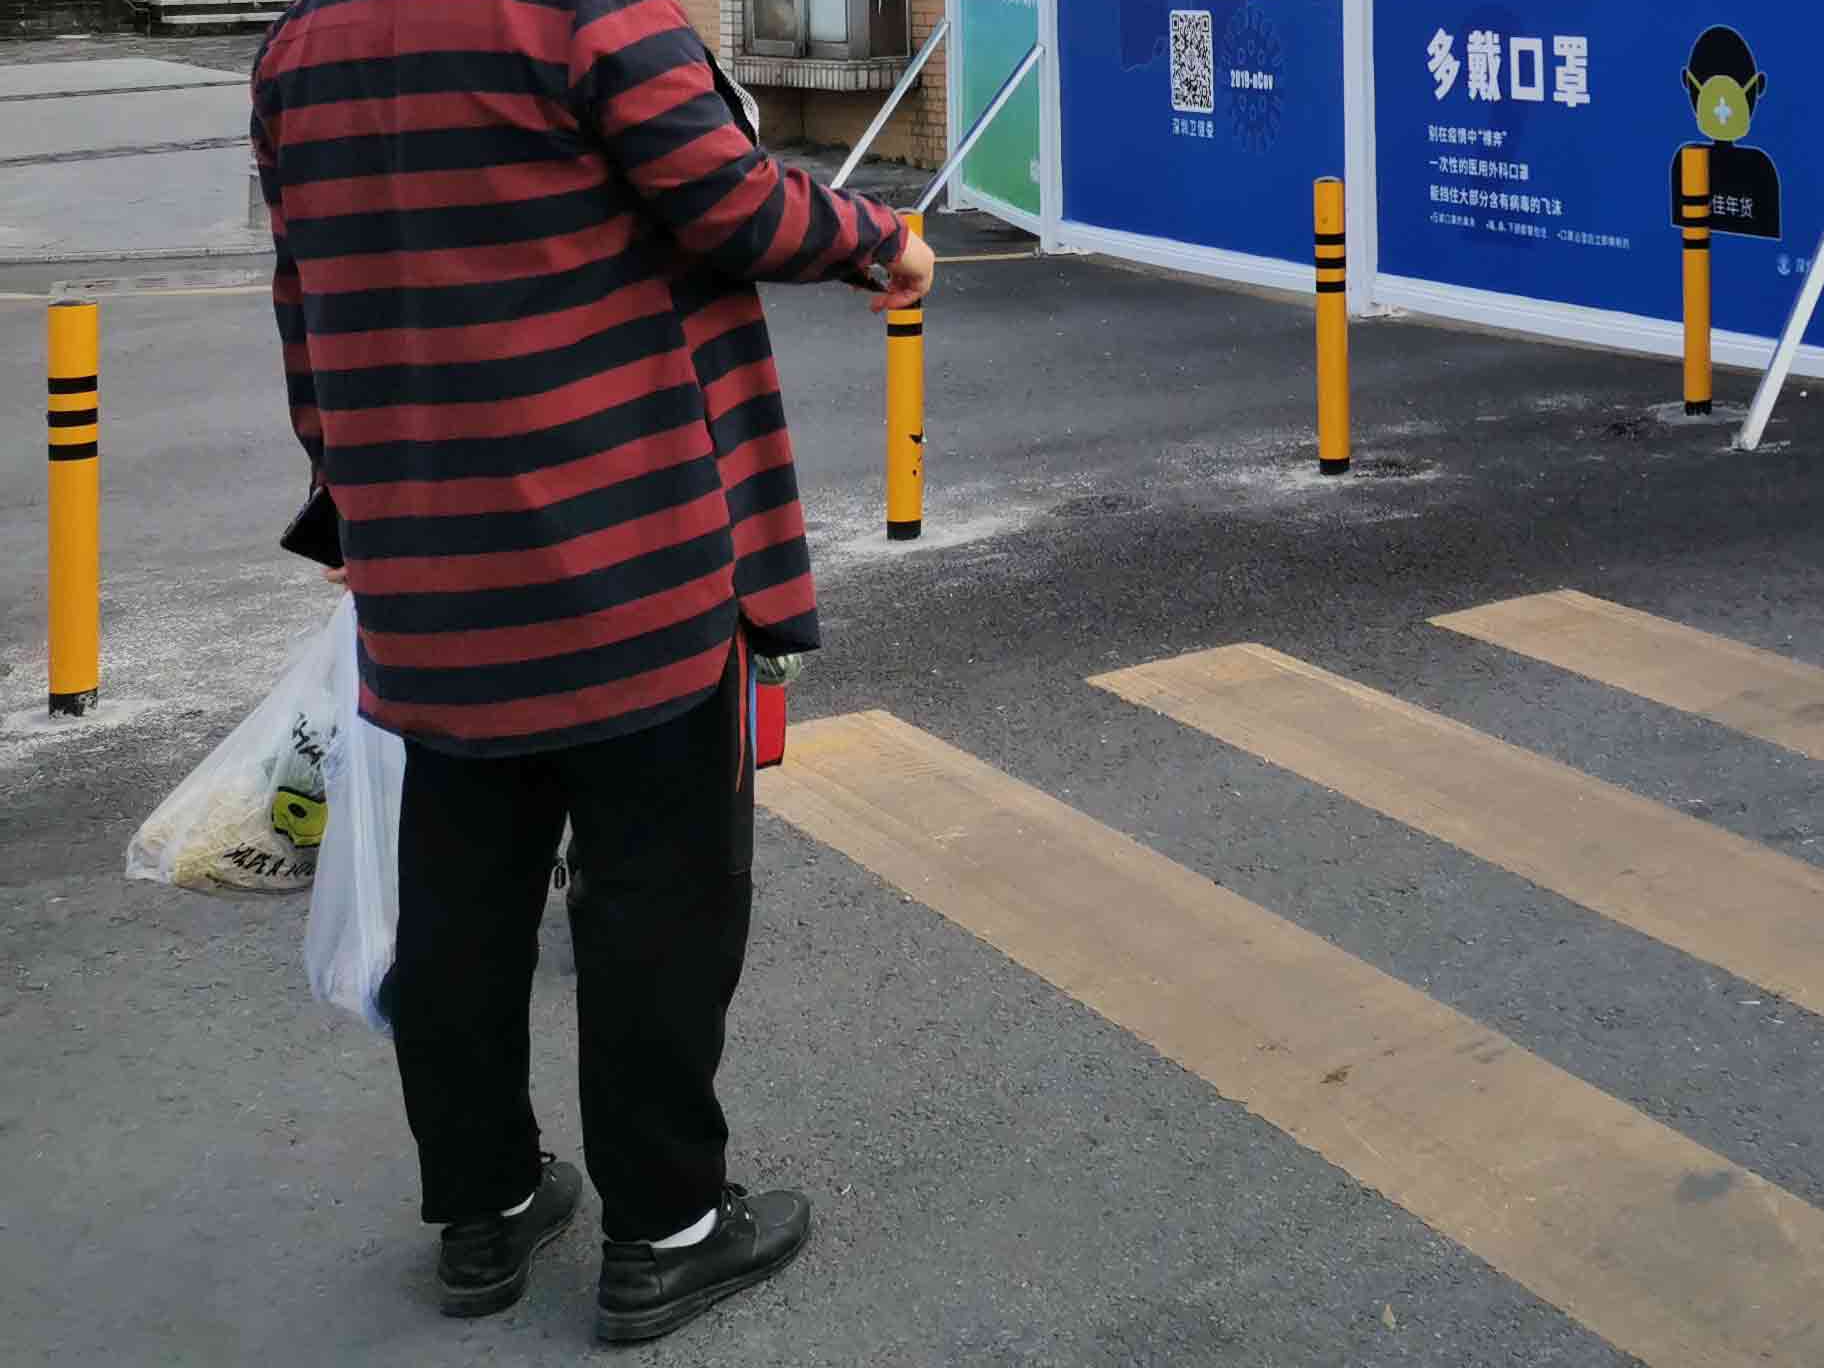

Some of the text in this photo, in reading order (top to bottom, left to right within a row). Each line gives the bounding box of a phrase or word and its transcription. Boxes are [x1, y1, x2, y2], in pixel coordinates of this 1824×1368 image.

[1426, 27, 1591, 108] 多戴口罩
[1429, 156, 1529, 181] 一次性的医用外科口罩
